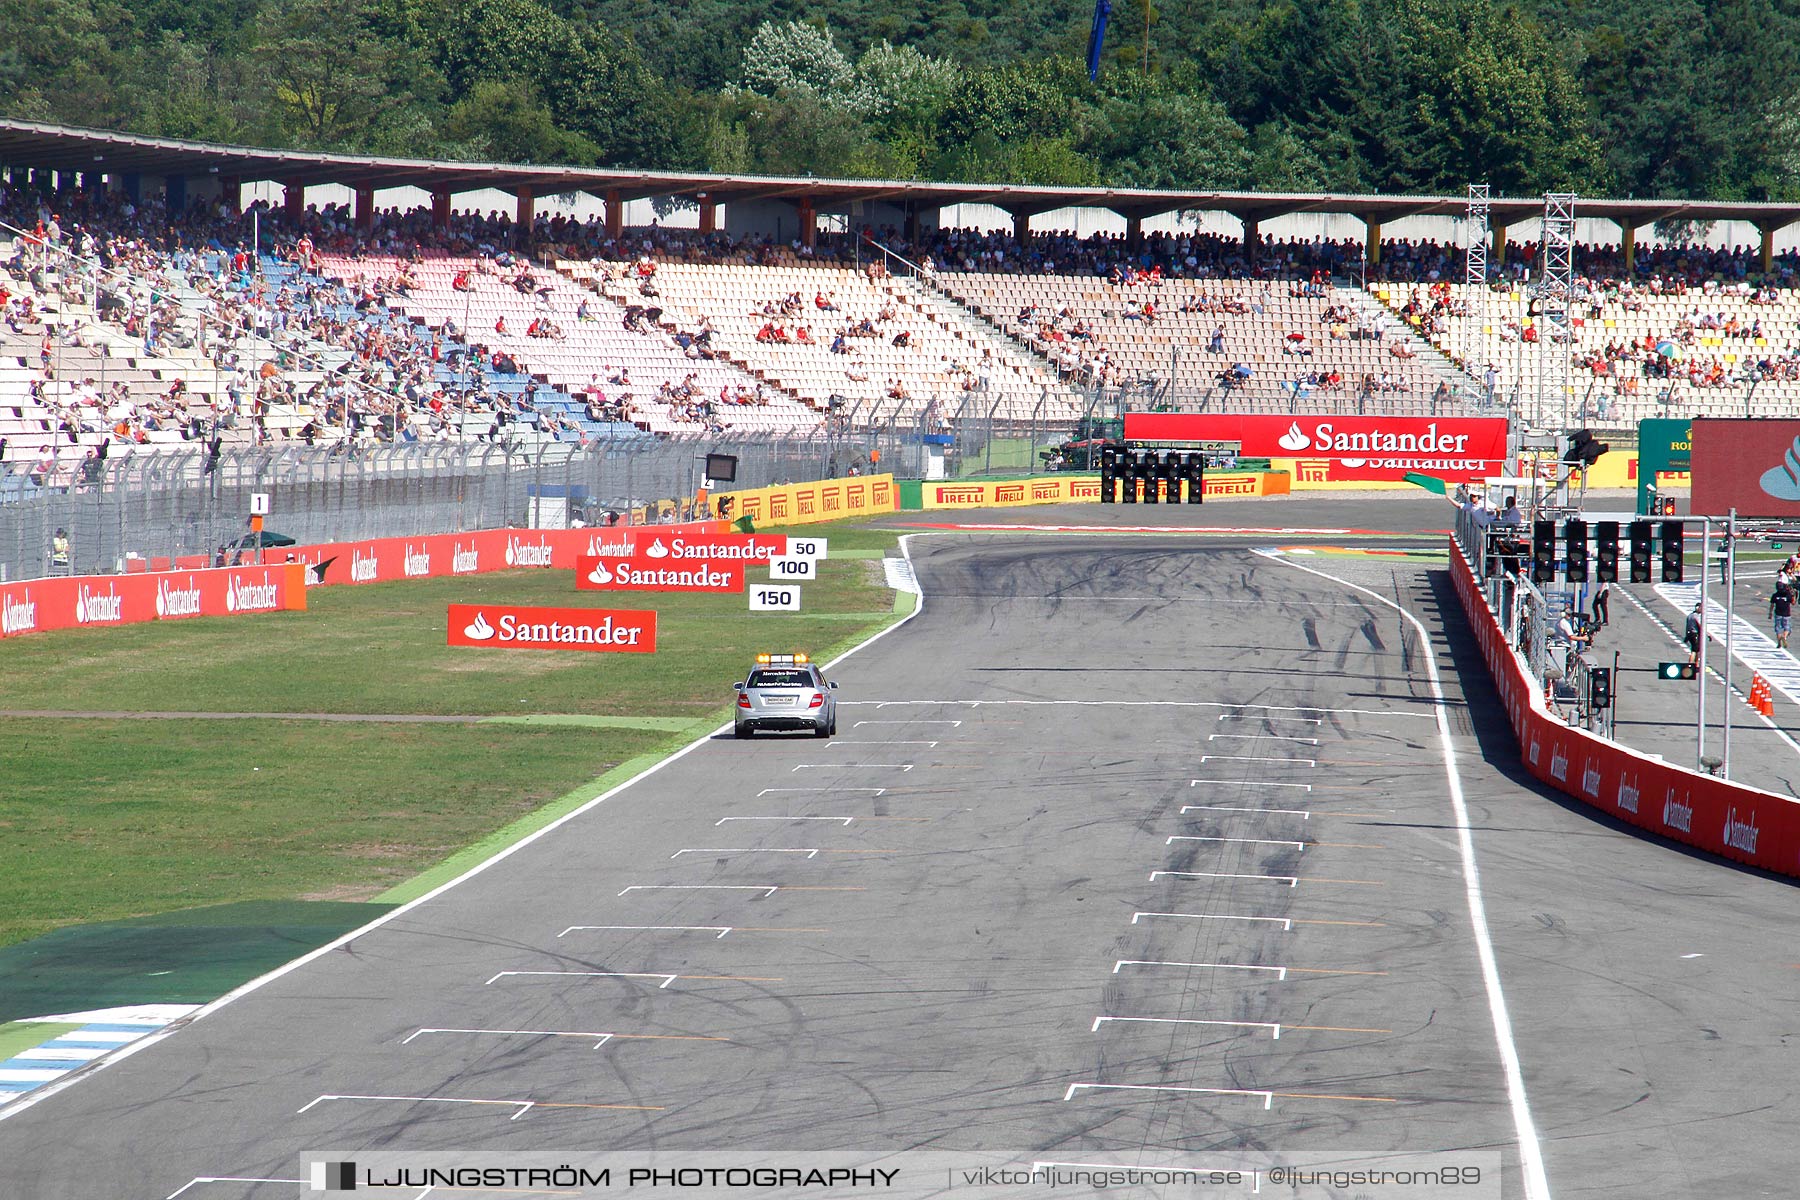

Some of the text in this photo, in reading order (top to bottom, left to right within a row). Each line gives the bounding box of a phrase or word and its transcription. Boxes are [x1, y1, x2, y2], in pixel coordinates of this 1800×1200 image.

[1315, 422, 1468, 453] Santander
[1296, 461, 1330, 481] PIR
[936, 486, 984, 503] PIRELLI
[995, 485, 1024, 502] PIRELLI
[1202, 477, 1256, 494] PIRELLI
[257, 497, 262, 510] 1
[514, 534, 552, 566] Santander
[671, 538, 776, 559] Santander
[796, 543, 815, 555] 50
[616, 563, 732, 587] Santander
[777, 561, 808, 574] 100
[164, 575, 200, 615] Santander
[235, 571, 277, 610] Santander
[757, 591, 791, 605] 150
[84, 581, 121, 622] Santander
[499, 615, 641, 645] Santander
